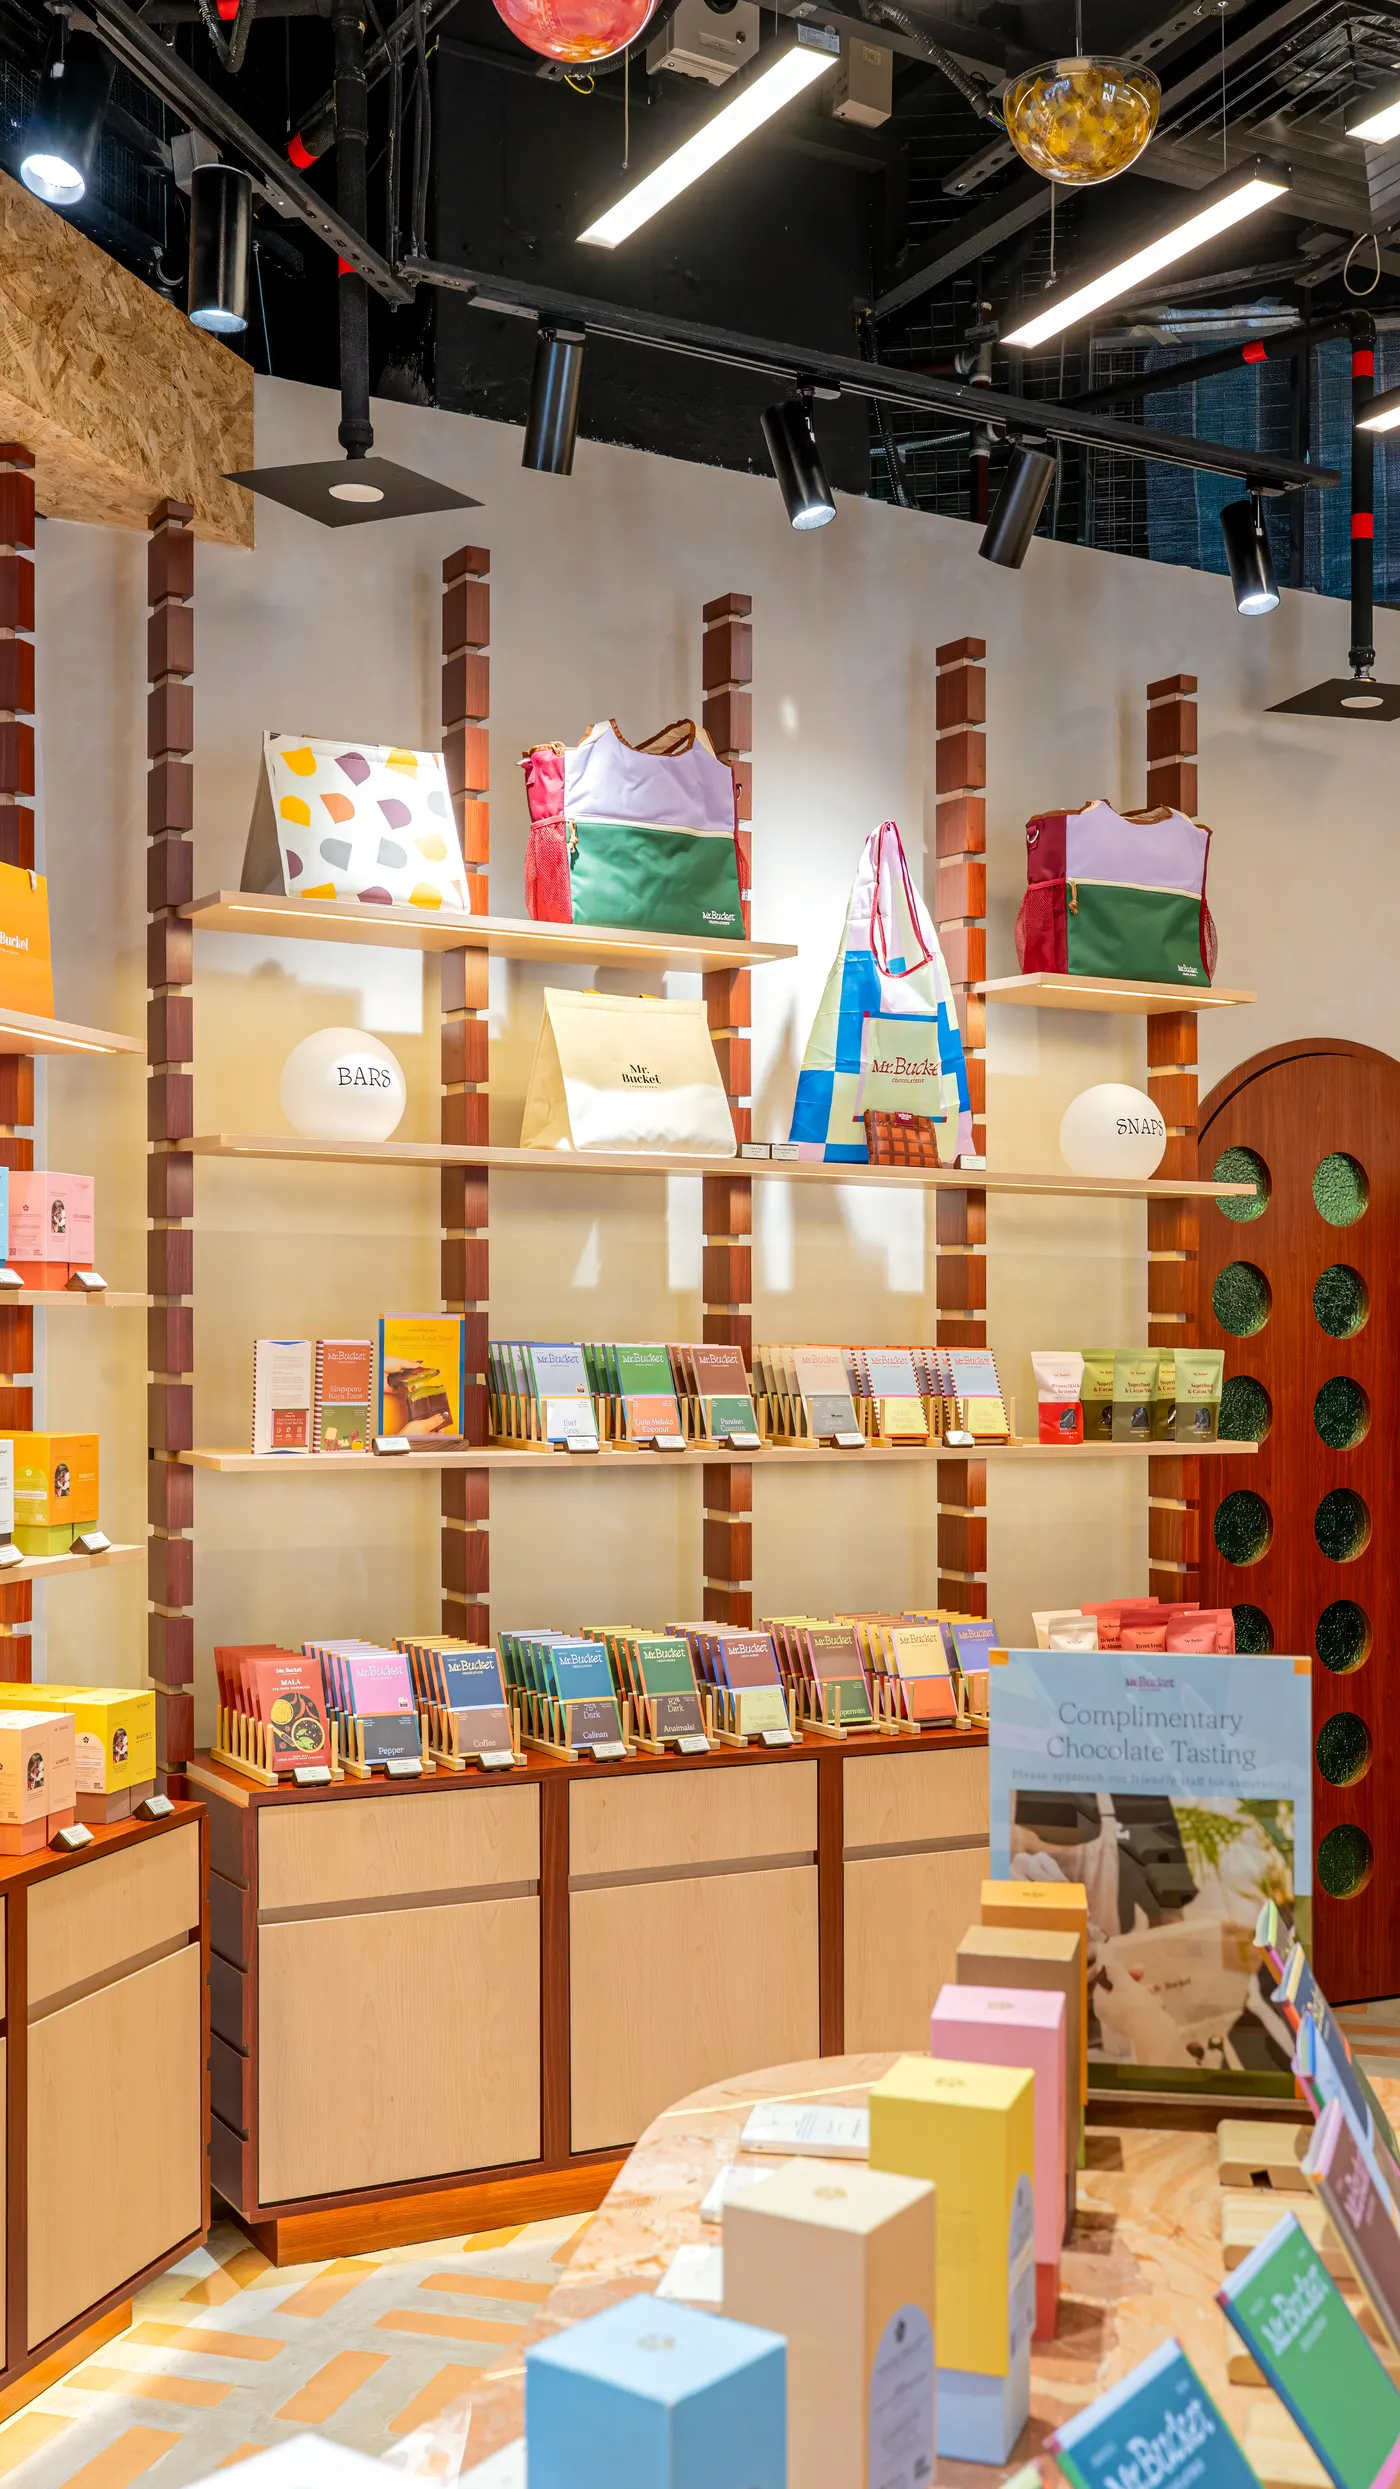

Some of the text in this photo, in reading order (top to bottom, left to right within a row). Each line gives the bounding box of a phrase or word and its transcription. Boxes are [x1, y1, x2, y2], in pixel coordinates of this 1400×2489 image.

[629, 1064, 650, 1074] Mr.
[337, 1066, 391, 1088] BARS
[622, 1073, 662, 1084] Bucket
[1116, 1118, 1164, 1137] SNAPS
[328, 1350, 366, 1360] Mr.Bucket
[536, 1354, 580, 1364] Mr.Bucket
[622, 1352, 664, 1363] Mr.Bucket
[698, 1353, 739, 1364] Mr.Bucket
[330, 1384, 362, 1394] Singapore
[814, 1635, 853, 1646] Mr.Bucket
[900, 1634, 938, 1645] Mr.Bucket
[643, 1648, 686, 1660] Mr.Bucket
[727, 1643, 769, 1655] Mr.Bucket
[559, 1654, 604, 1665] Mr.Bucket
[356, 1665, 404, 1677] Mr.Bucket
[448, 1659, 495, 1672] Mr.Bucket
[668, 1704, 684, 1713] Dark
[832, 1708, 866, 1717] Pppermint
[584, 1710, 602, 1720] Dark
[1058, 1701, 1244, 1737] Complimentary
[664, 1724, 696, 1733] Anaimalai
[582, 1732, 609, 1740] Calinan
[473, 1739, 496, 1748] Coffee
[378, 1747, 404, 1757] Pepper
[1046, 1735, 1257, 1772] Chocolate Tasting
[1052, 1772, 1105, 1785] approach
[1108, 1774, 1128, 1784] our
[1131, 1773, 1176, 1788] friendly
[1181, 1776, 1205, 1788] staff
[1208, 1776, 1224, 1788] for
[1260, 2264, 1331, 2356] Mr.Bucket
